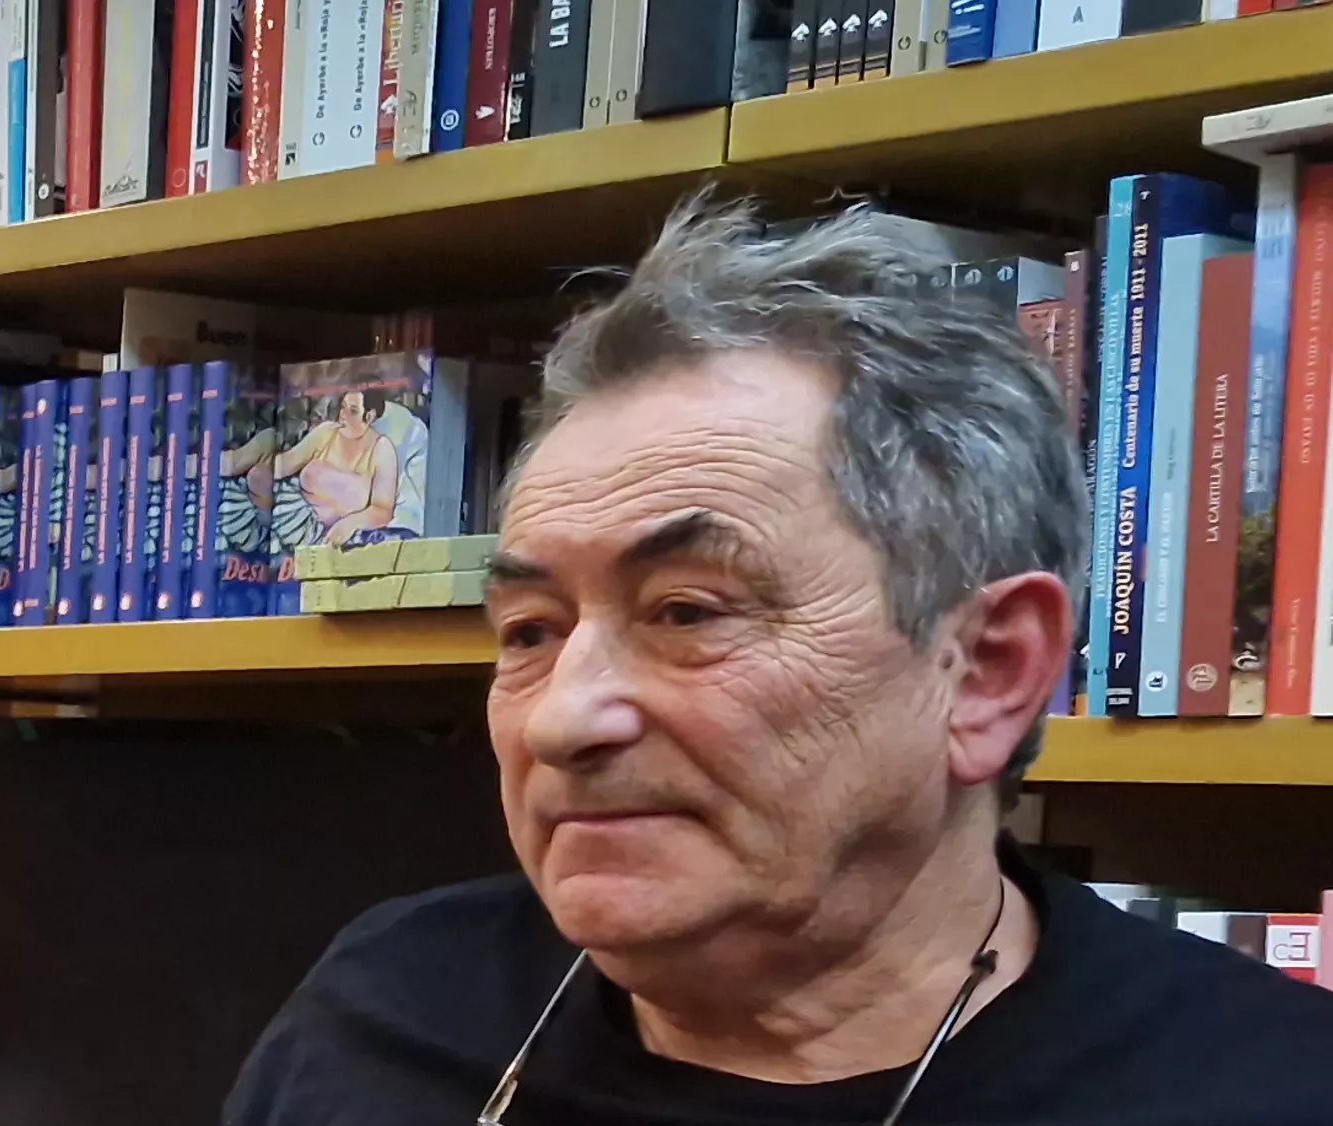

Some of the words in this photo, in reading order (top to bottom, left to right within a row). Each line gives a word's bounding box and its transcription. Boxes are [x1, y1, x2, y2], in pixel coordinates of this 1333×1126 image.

[357, 34, 366, 45] la
[549, 22, 569, 48] LA
[317, 65, 328, 101] Ayerbe
[355, 57, 365, 93] Ayerbe
[316, 104, 326, 119] De
[353, 97, 363, 111] De
[1133, 222, 1148, 257] 2011
[1130, 306, 1144, 355] muerte
[1129, 356, 1142, 373] su
[1125, 376, 1140, 392] de
[1214, 373, 1230, 418] LITERA
[1121, 393, 1140, 469] Centenario
[1212, 420, 1226, 439] LA
[1211, 445, 1224, 459] DE
[1208, 462, 1224, 523] CARTILLA
[1118, 486, 1138, 546] COSTA
[1205, 524, 1220, 544] LA
[1114, 550, 1136, 635] JOAQUÍN
